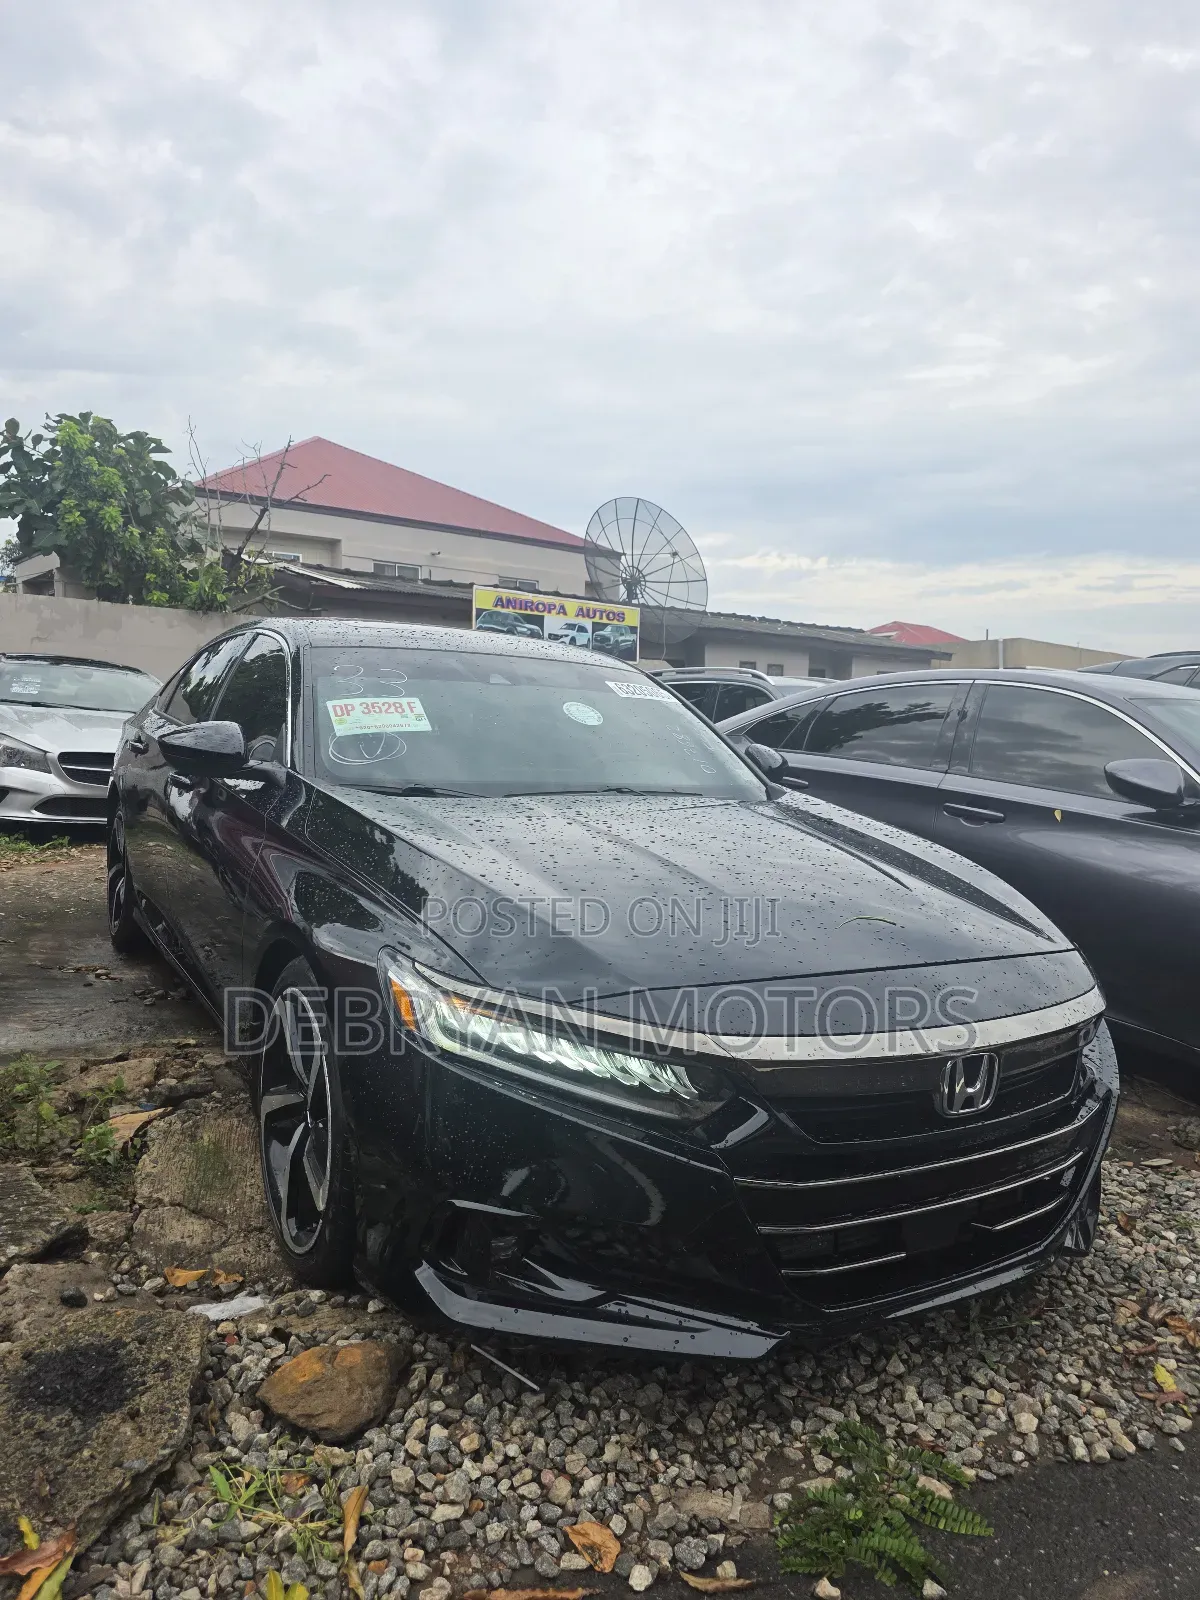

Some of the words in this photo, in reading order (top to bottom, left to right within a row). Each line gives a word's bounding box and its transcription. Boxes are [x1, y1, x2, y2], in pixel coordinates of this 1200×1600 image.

[492, 594, 567, 617] ANIROPA
[575, 605, 626, 623] AUTOS
[331, 703, 356, 718] DP
[359, 701, 406, 715] 3528
[406, 701, 417, 714] F
